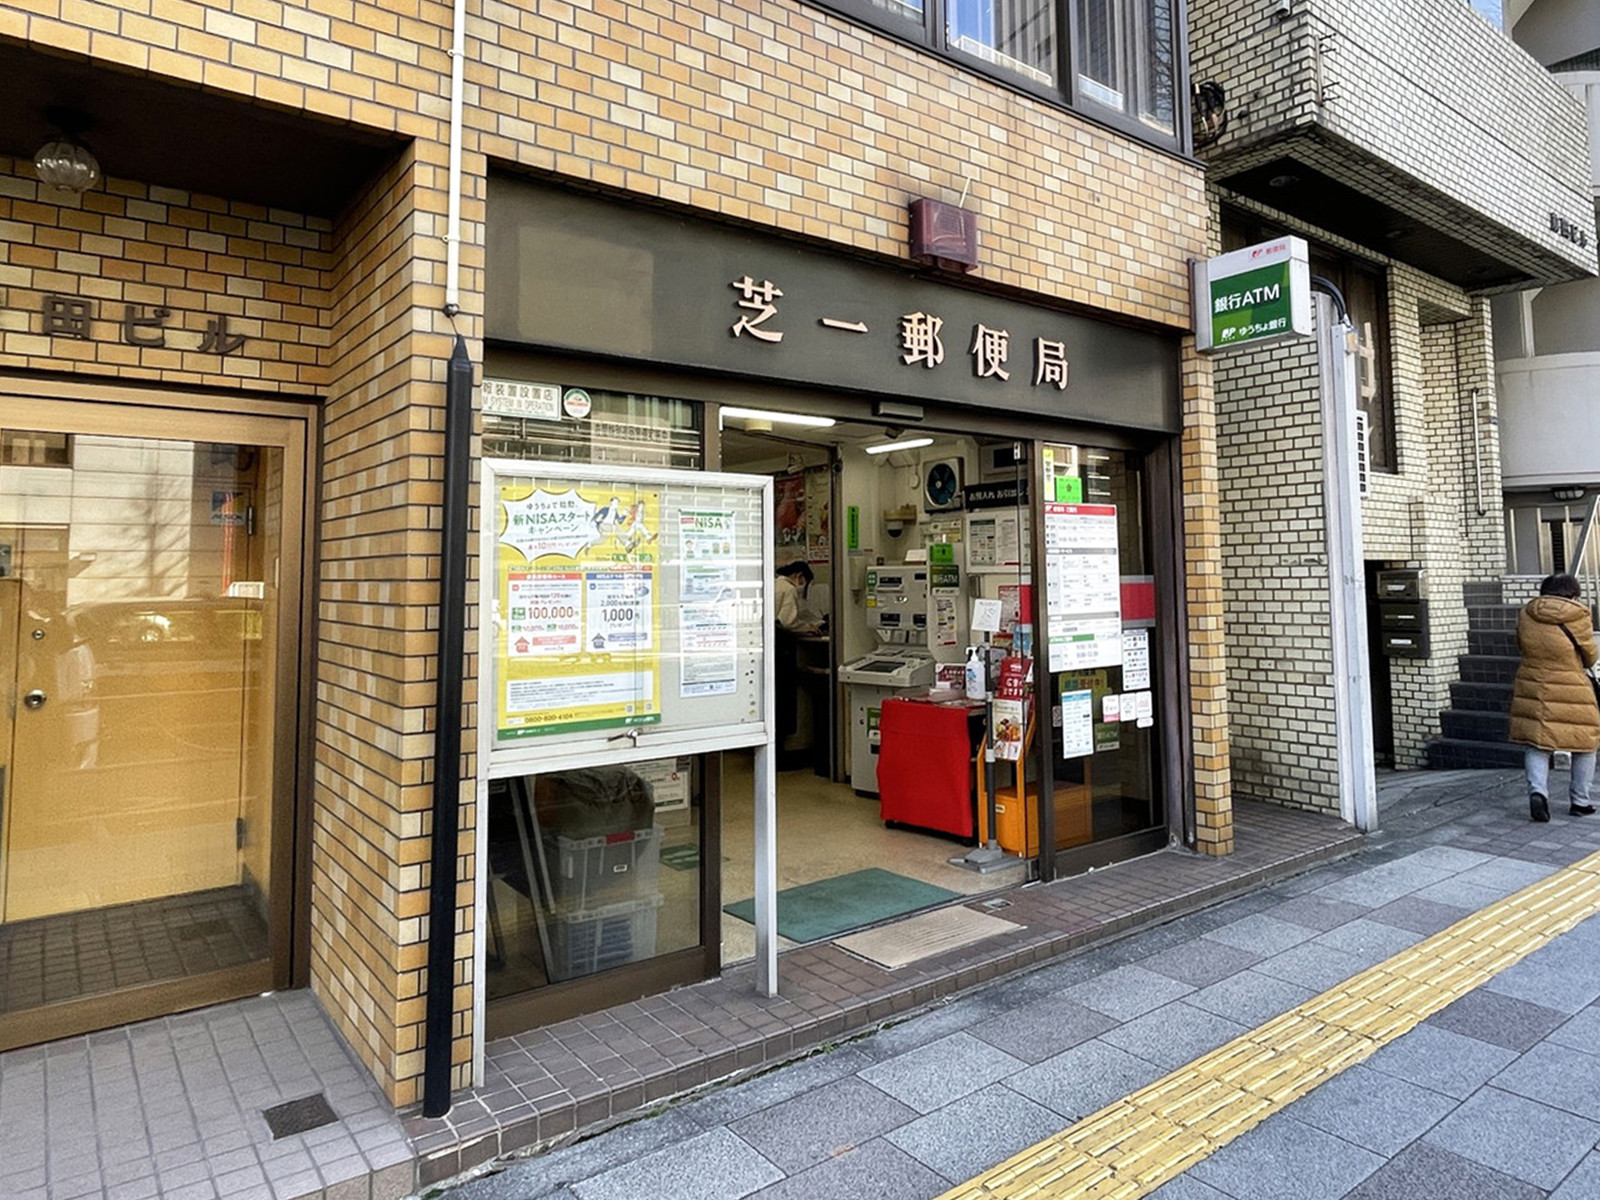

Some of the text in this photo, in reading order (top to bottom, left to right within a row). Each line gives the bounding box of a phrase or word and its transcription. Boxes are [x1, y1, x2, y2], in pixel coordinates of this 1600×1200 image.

[1214, 283, 1280, 314] 銀行ATM
[732, 276, 1069, 390] 芝一郵便局
[1239, 317, 1287, 336] ゆうちょ銀行
[513, 510, 590, 526] 新NISAスタート
[695, 517, 723, 529] NISA
[528, 523, 579, 535] キャンペーン
